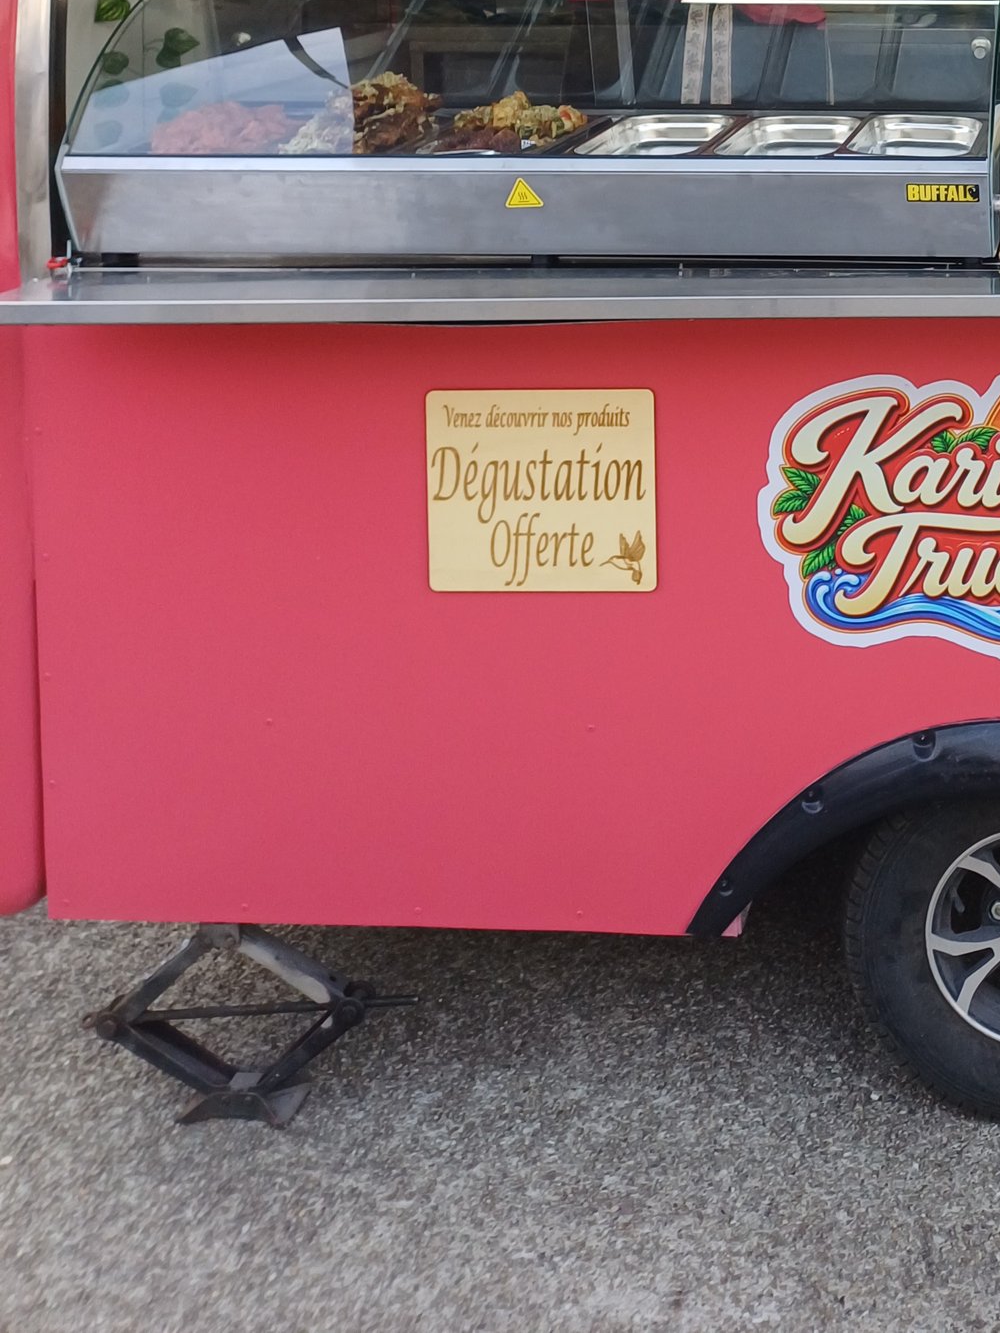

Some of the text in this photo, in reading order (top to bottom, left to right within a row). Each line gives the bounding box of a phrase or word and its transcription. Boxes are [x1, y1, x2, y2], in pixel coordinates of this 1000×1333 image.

[443, 404, 631, 436] Venez découvrir nos produits
[431, 442, 646, 524] Dégustation
[490, 512, 595, 587] Offerte
